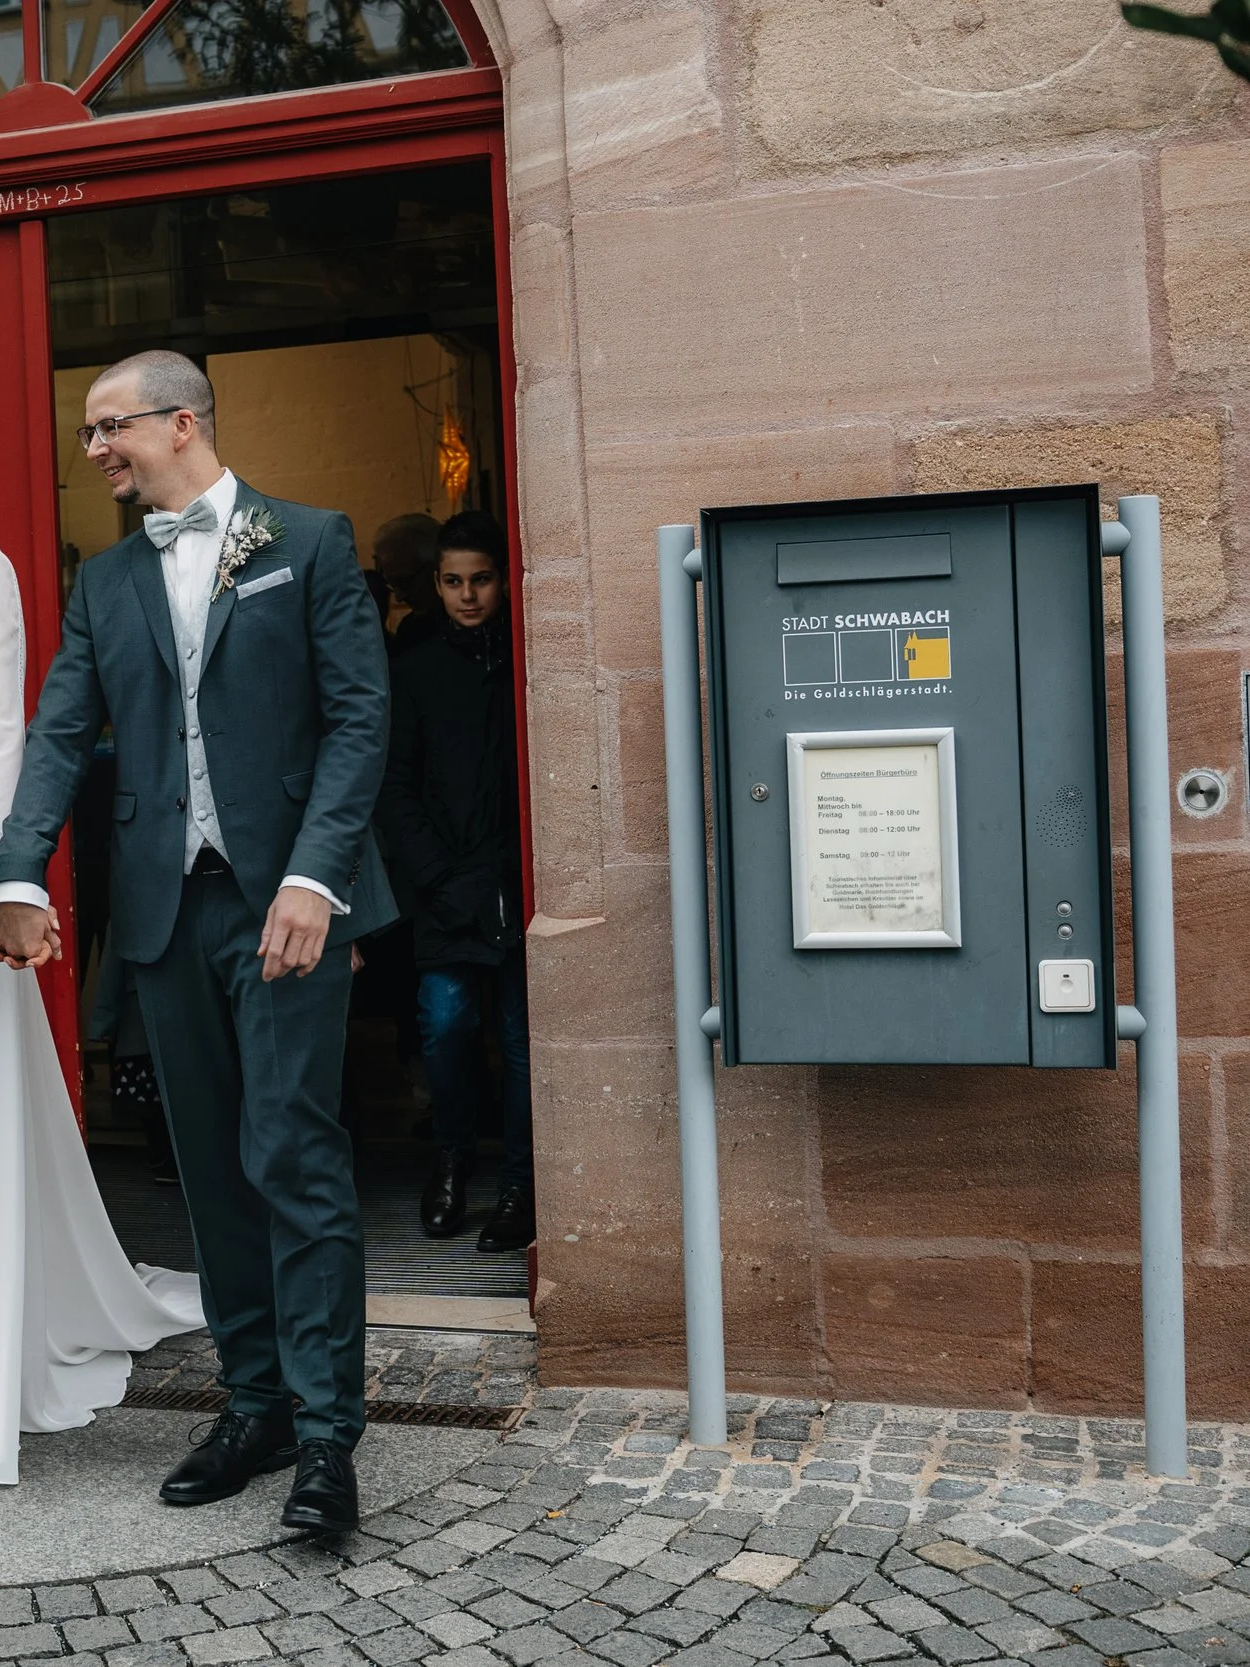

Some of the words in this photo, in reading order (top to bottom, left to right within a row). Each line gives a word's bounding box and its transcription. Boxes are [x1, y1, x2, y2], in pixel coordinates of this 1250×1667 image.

[782, 615, 829, 631] STADT
[835, 610, 950, 628] SCHWABACH
[784, 690, 806, 700] Die
[814, 683, 953, 699] Goldschlägerstadt.
[820, 770, 875, 778] Öffnungszeiten
[876, 769, 918, 777] Bürgerbüro
[818, 811, 843, 819] Freitag
[819, 852, 850, 860] Samstag
